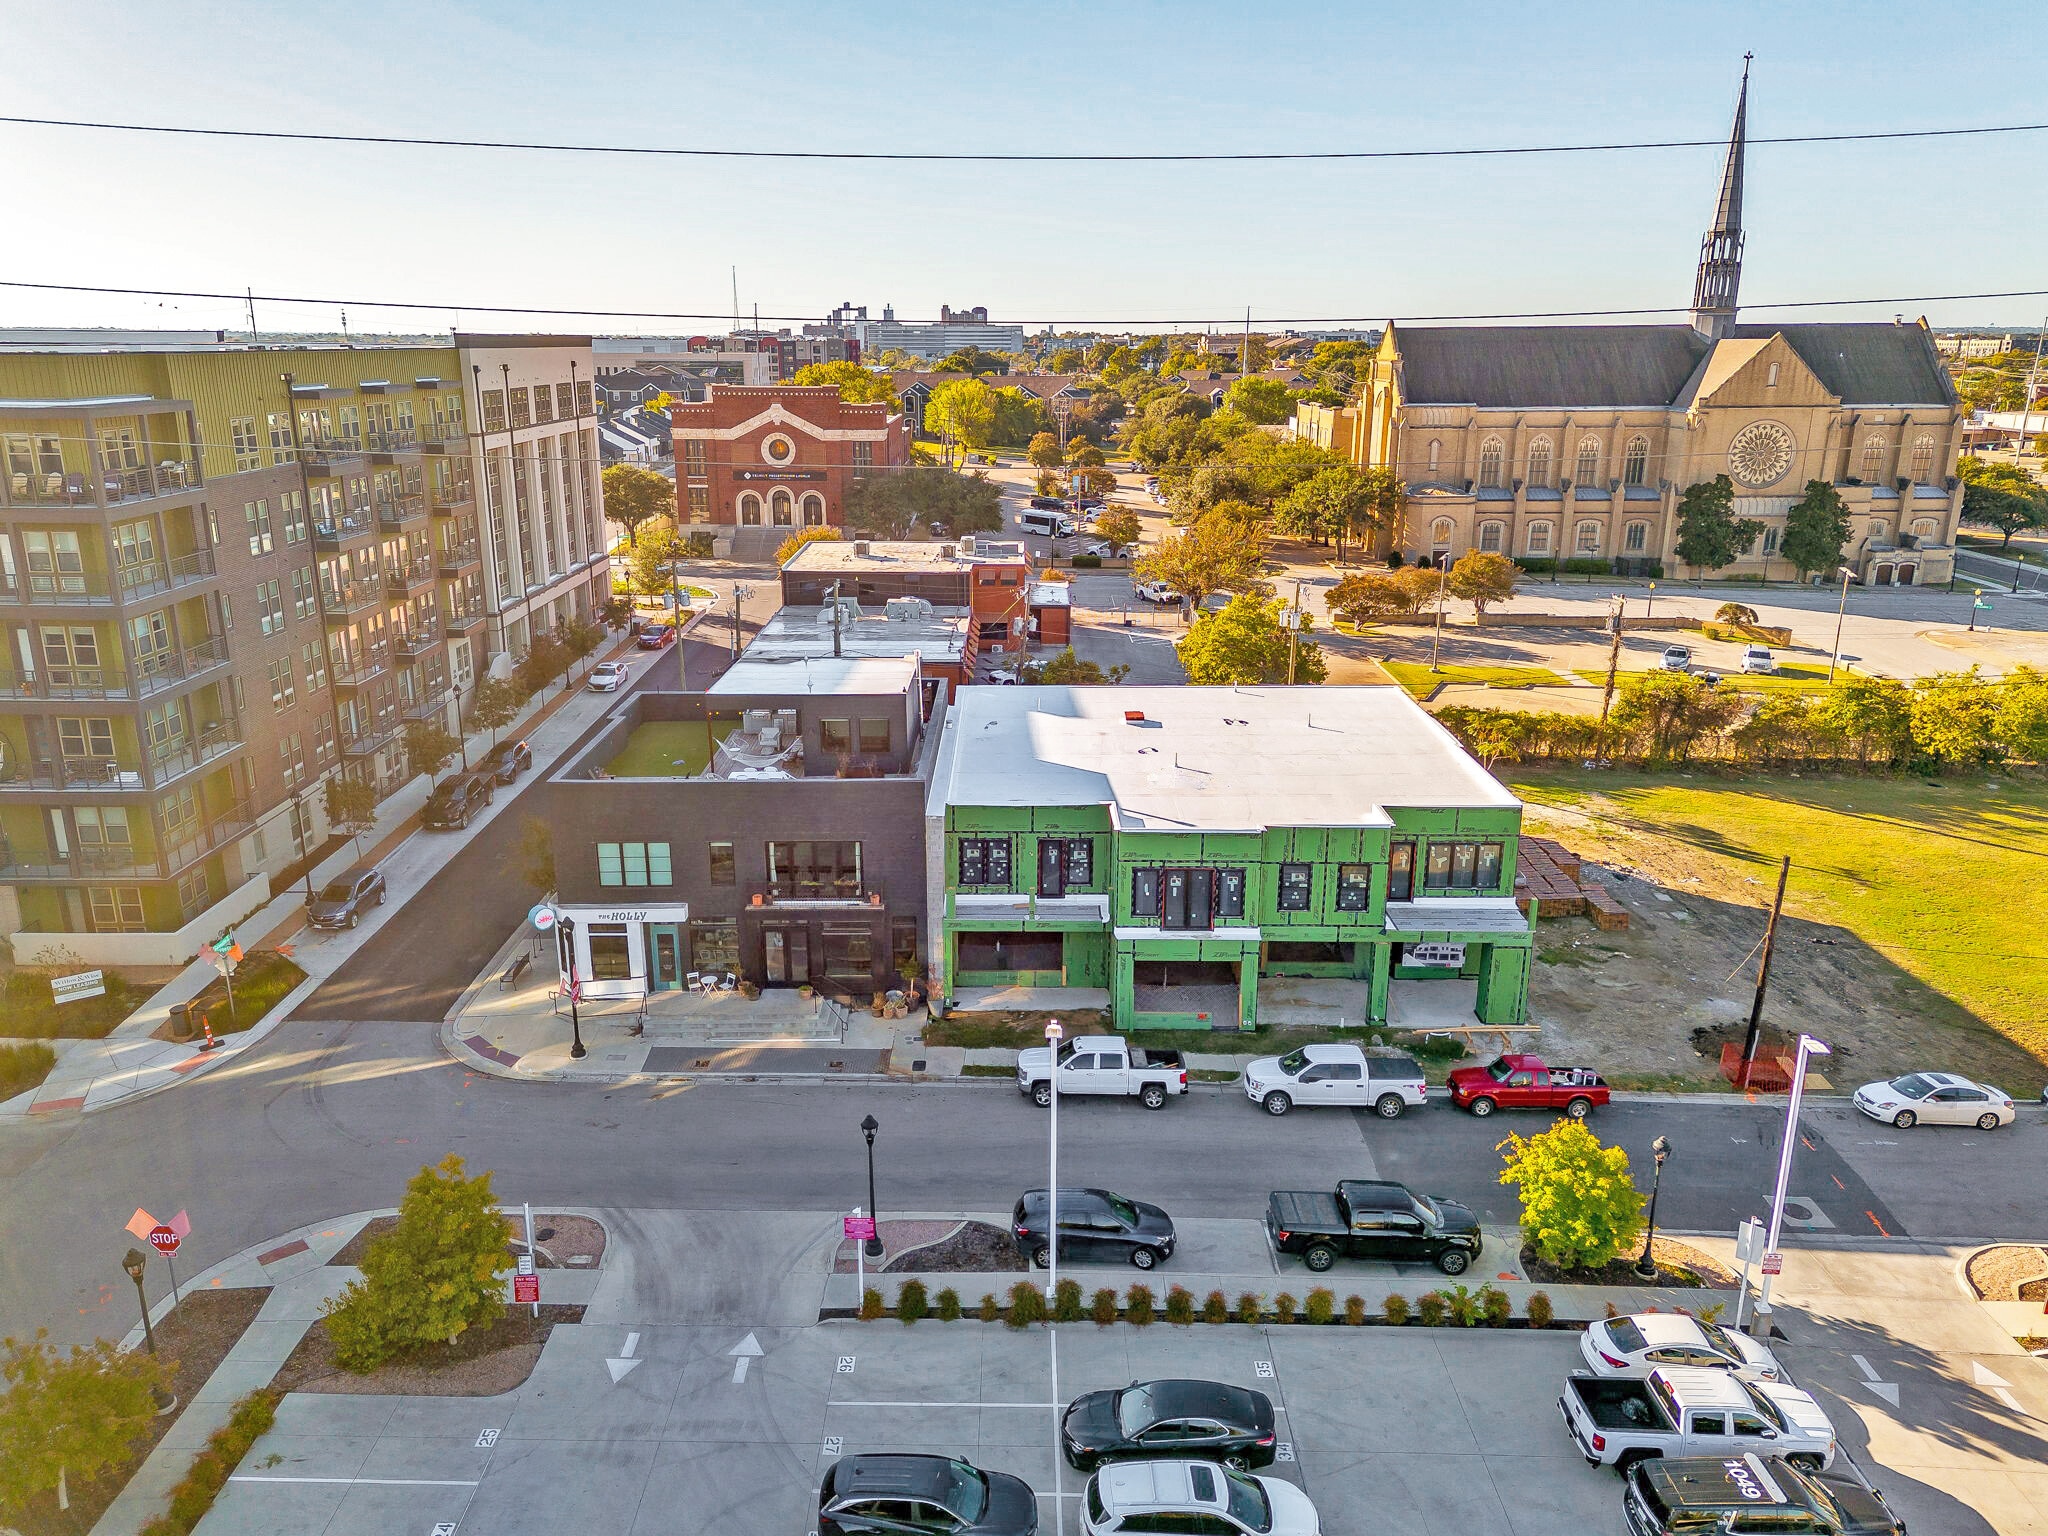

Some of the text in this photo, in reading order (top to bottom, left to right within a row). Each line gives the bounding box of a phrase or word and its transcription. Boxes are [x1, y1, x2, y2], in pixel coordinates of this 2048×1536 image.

[611, 911, 647, 921] HOLLY
[73, 980, 99, 988] LEASING
[151, 1233, 178, 1244] STOP
[840, 1356, 854, 1372] 26
[1258, 1361, 1272, 1377] 35
[478, 1429, 497, 1446] 25
[825, 1437, 840, 1455] 27
[1278, 1442, 1291, 1461] 34
[1723, 1459, 1761, 1499] 1049
